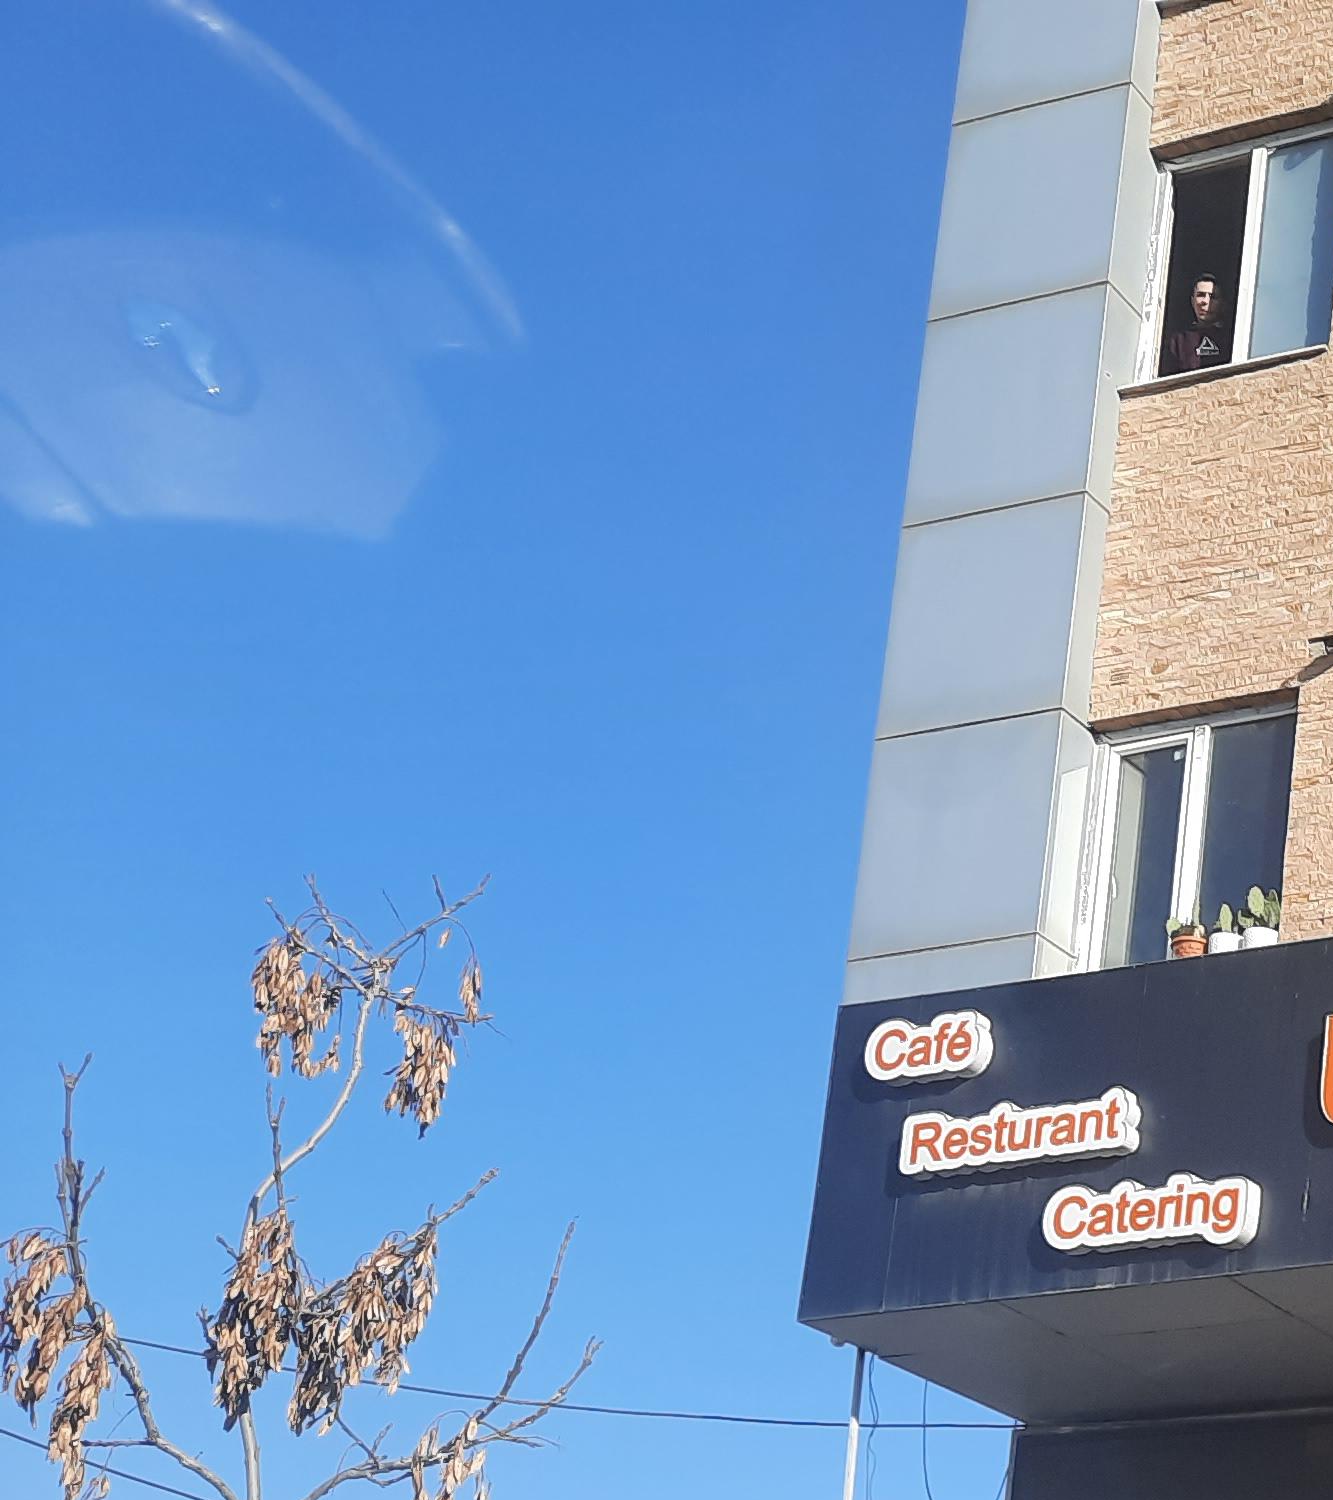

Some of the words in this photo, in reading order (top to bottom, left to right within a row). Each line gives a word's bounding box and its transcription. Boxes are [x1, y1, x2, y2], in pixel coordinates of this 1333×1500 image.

[874, 1020, 973, 1071] Café
[909, 1098, 1121, 1164] Resturant
[1052, 1183, 1242, 1242] Catering
